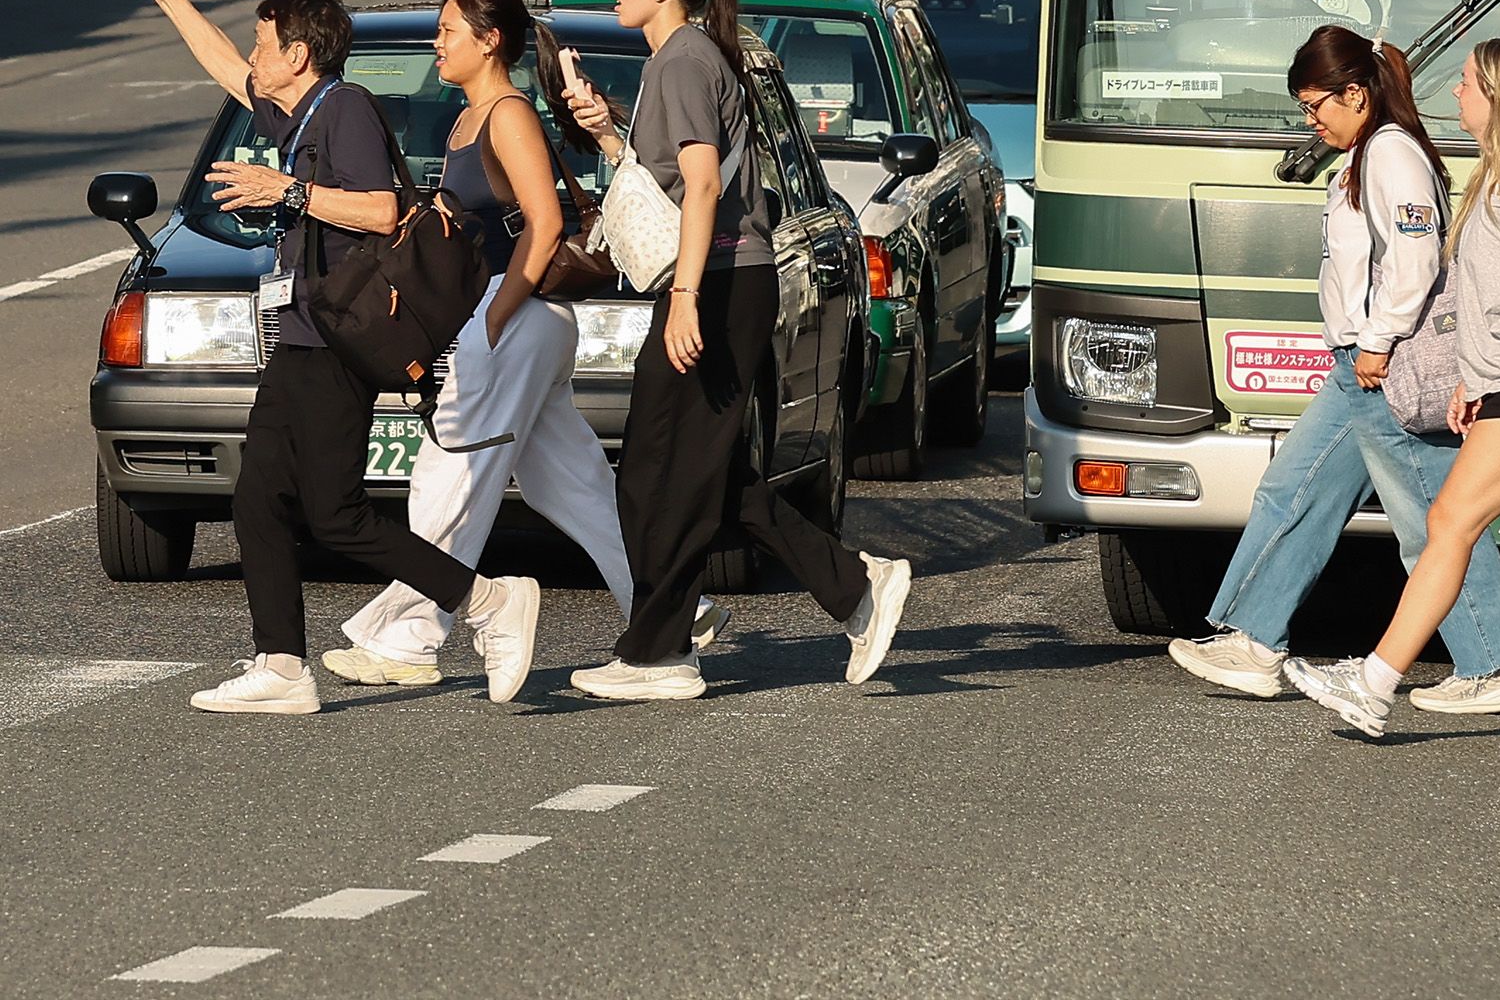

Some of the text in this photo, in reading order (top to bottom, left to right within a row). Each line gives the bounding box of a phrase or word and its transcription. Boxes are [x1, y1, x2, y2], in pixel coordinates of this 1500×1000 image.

[1107, 79, 1218, 92] ドライブレコーダー搭載車両
[1268, 375, 1306, 384] 国土交通省
